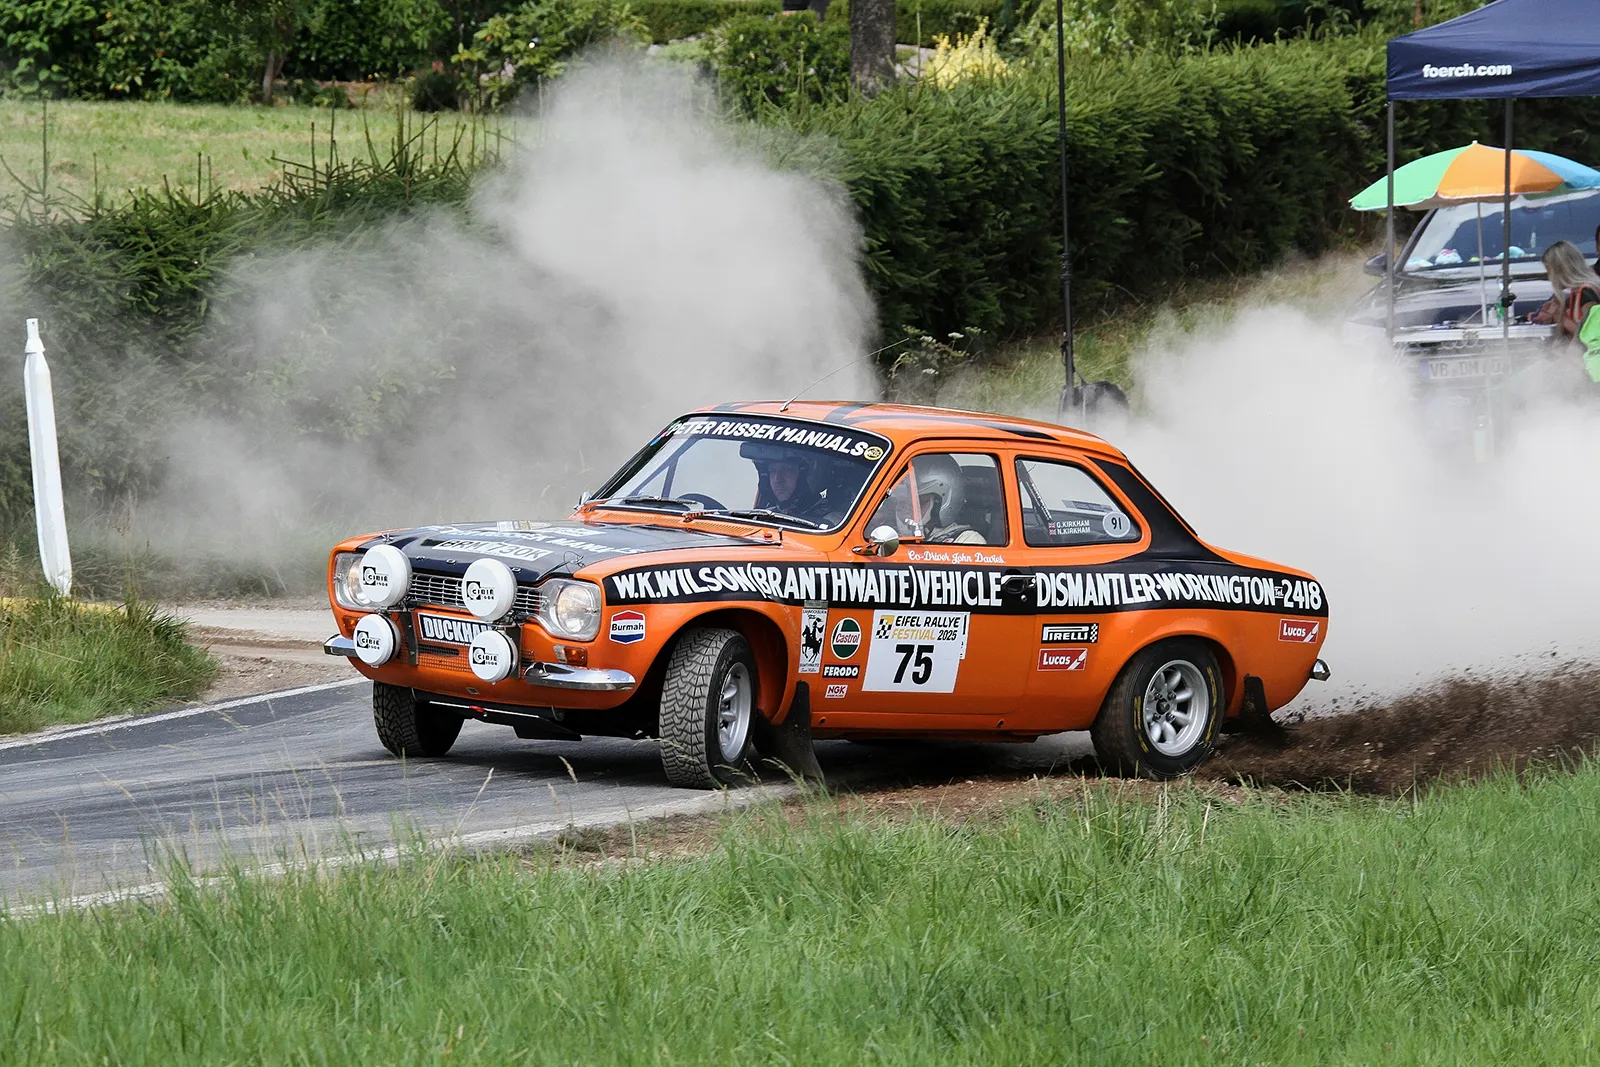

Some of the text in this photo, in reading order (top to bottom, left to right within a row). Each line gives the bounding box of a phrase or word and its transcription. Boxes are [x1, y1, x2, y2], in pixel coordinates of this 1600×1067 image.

[1422, 63, 1512, 78] foerch.com
[668, 420, 714, 436] PETER
[713, 421, 783, 440] RUSSEK
[776, 429, 869, 457] MANUALS
[1111, 517, 1122, 530] 91
[907, 549, 951, 561] Co-Driver
[952, 552, 972, 564] John
[917, 570, 1002, 606] VEHICLE
[1281, 579, 1322, 610] 2418
[611, 622, 644, 631] Burmah
[895, 616, 961, 628] EIFEL RALLYE
[891, 629, 958, 641] FESTIVAL 2025
[1042, 626, 1090, 641] PIRELLI
[1283, 623, 1307, 637] Lucas
[835, 632, 860, 644] Castrol
[893, 644, 935, 685] 75
[1042, 652, 1071, 666] Lucas
[823, 666, 859, 677] FERODO
[827, 685, 847, 694] NGK
